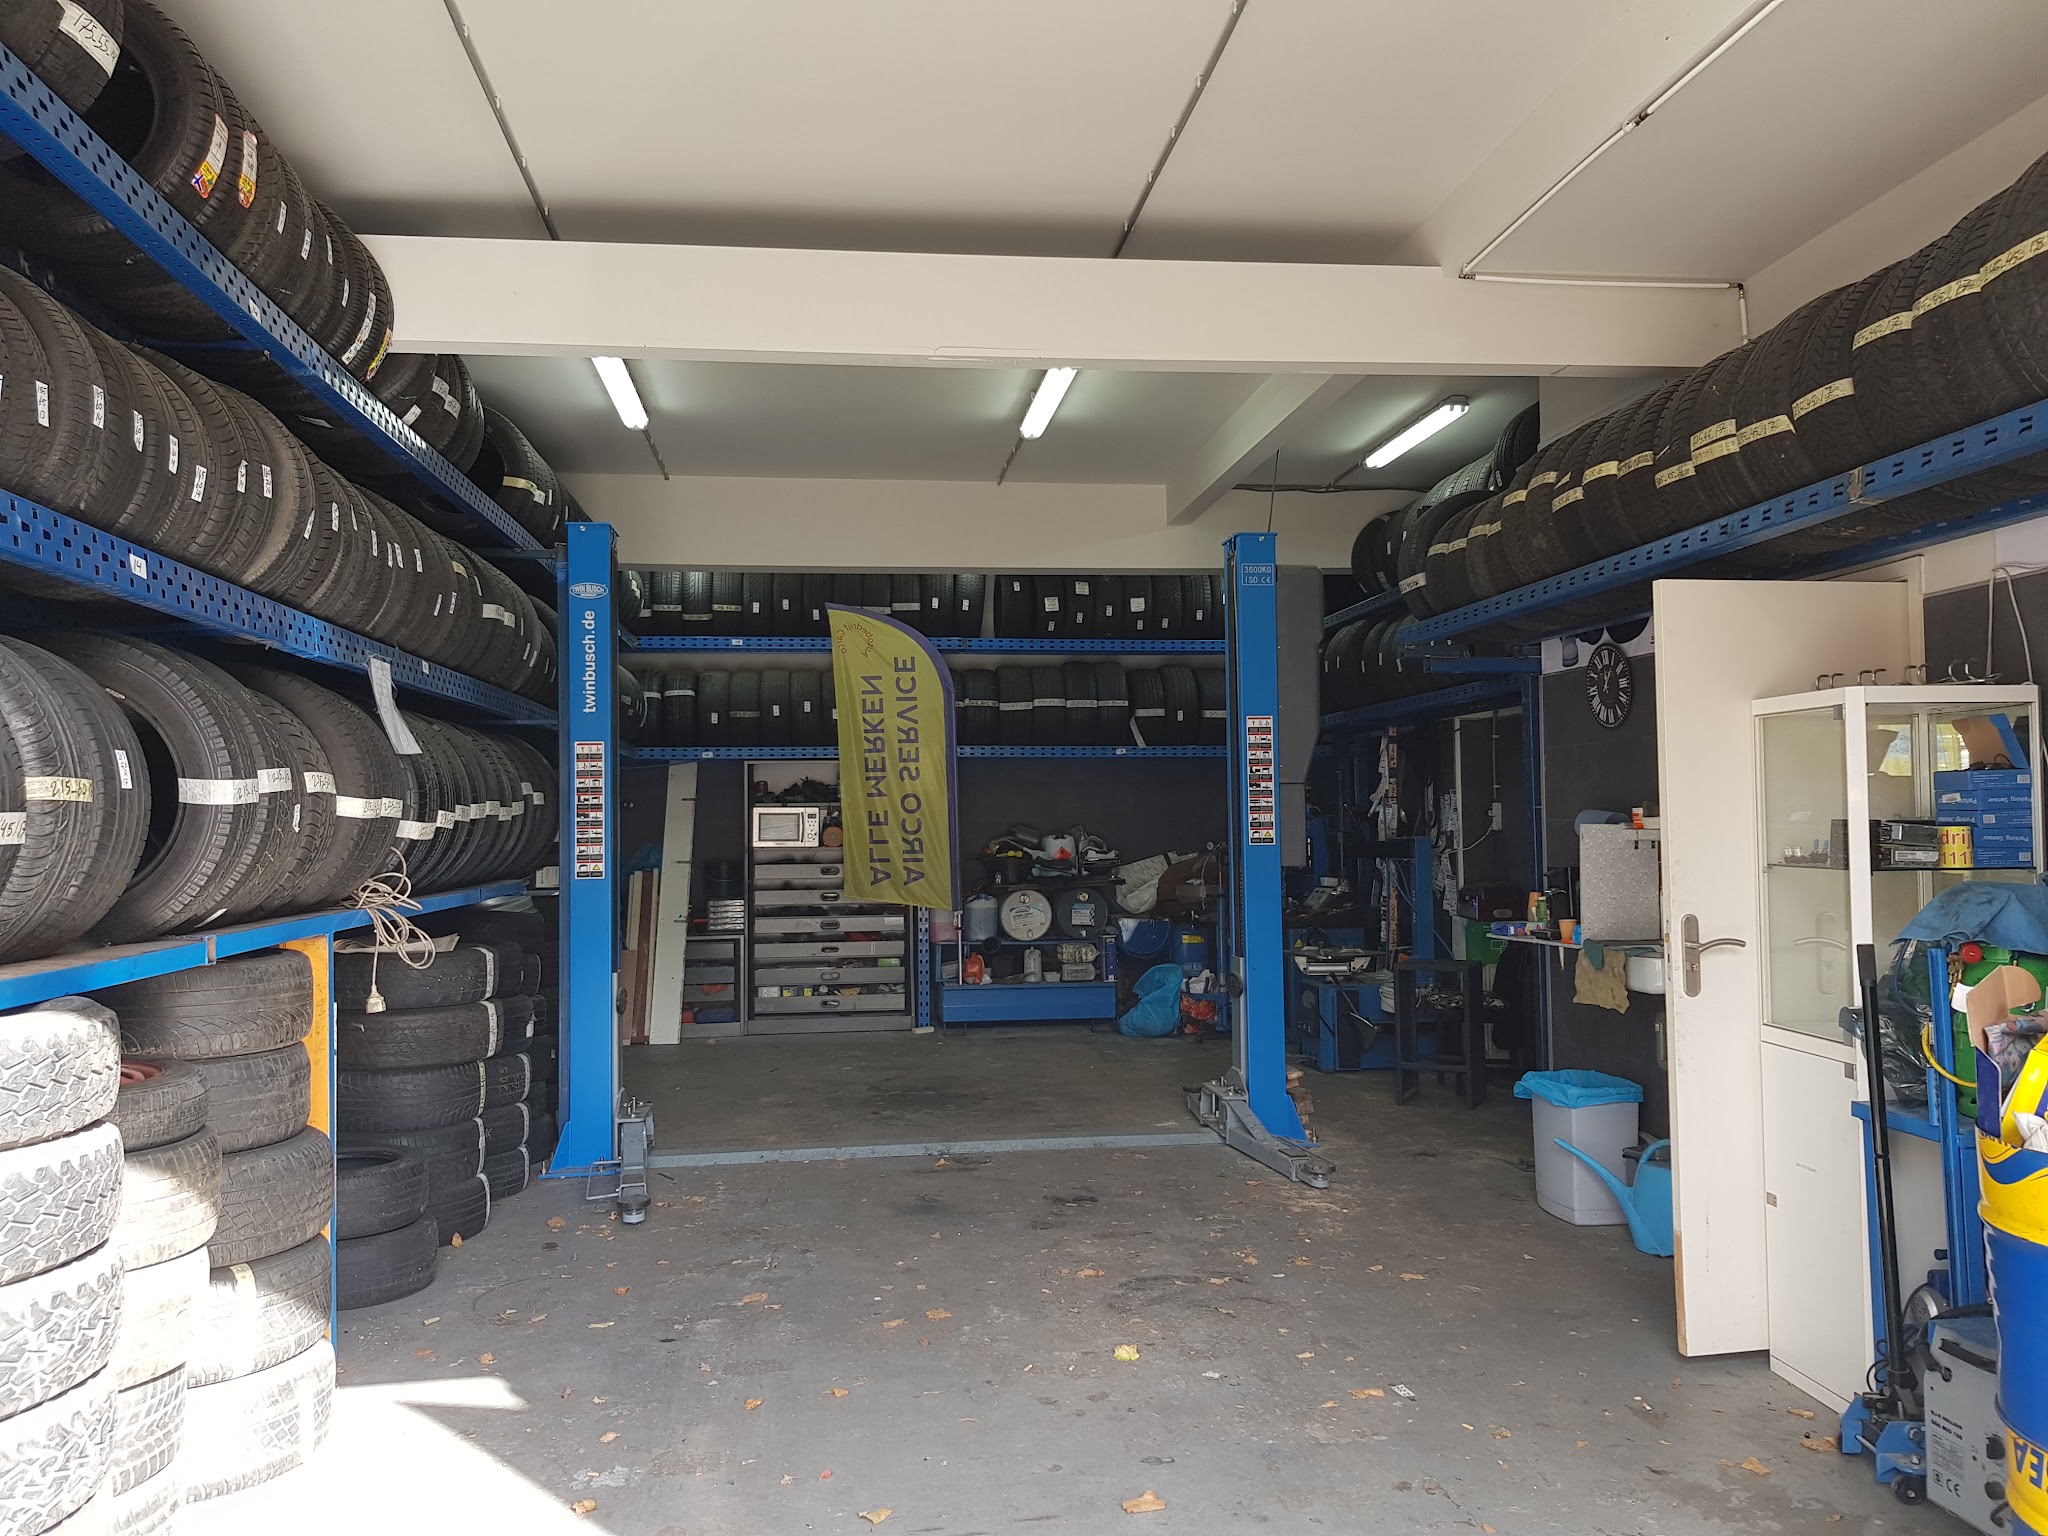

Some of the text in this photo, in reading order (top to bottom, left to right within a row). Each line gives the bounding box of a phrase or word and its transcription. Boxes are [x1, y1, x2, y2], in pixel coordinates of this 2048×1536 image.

[132, 557, 145, 573] 14
[1245, 576, 1258, 584] ISO
[586, 584, 605, 594] BUSCH
[582, 610, 596, 713] twinbusch.de
[2006, 834, 2030, 842] Parking
[1941, 851, 1973, 866] 111
[2013, 1438, 2048, 1493] EA
